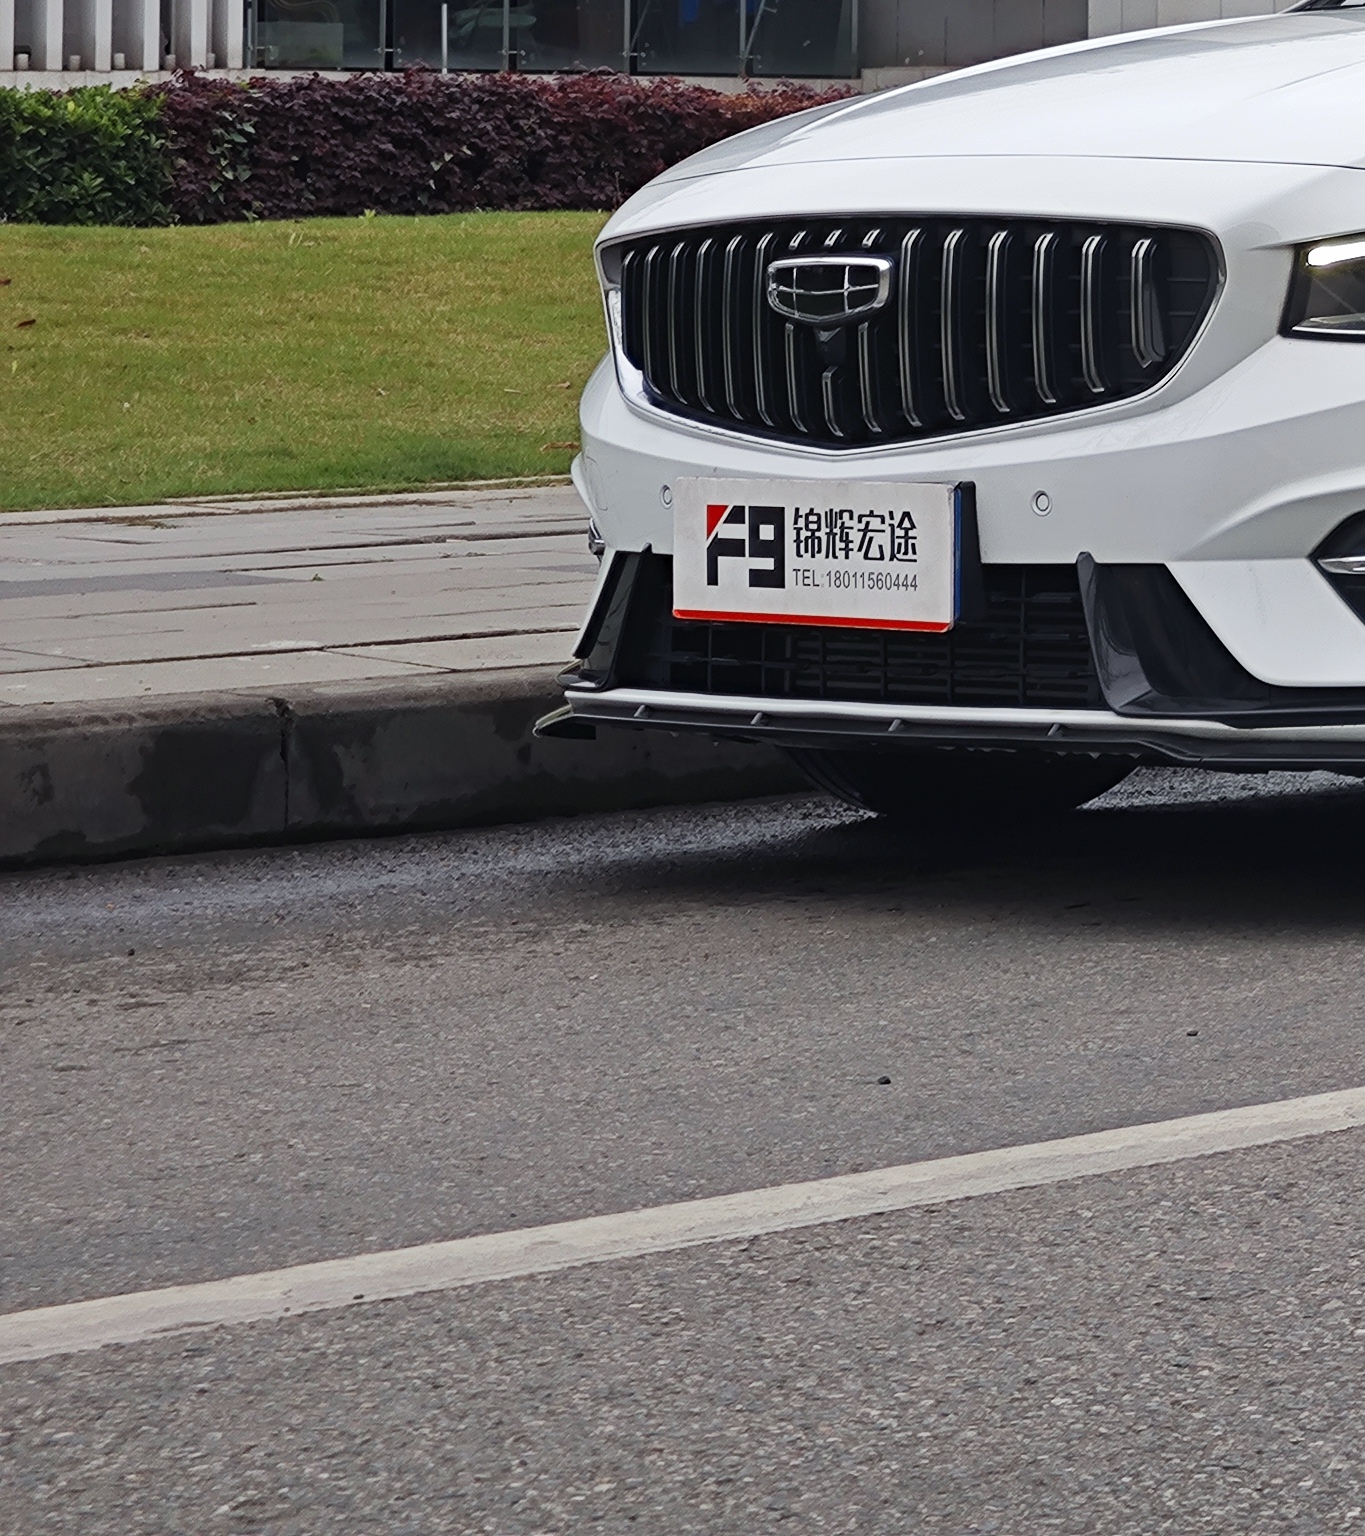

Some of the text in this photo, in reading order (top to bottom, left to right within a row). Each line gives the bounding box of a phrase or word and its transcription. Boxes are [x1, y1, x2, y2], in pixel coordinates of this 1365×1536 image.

[707, 504, 786, 589] F9
[793, 507, 918, 563] 锦辉宏途
